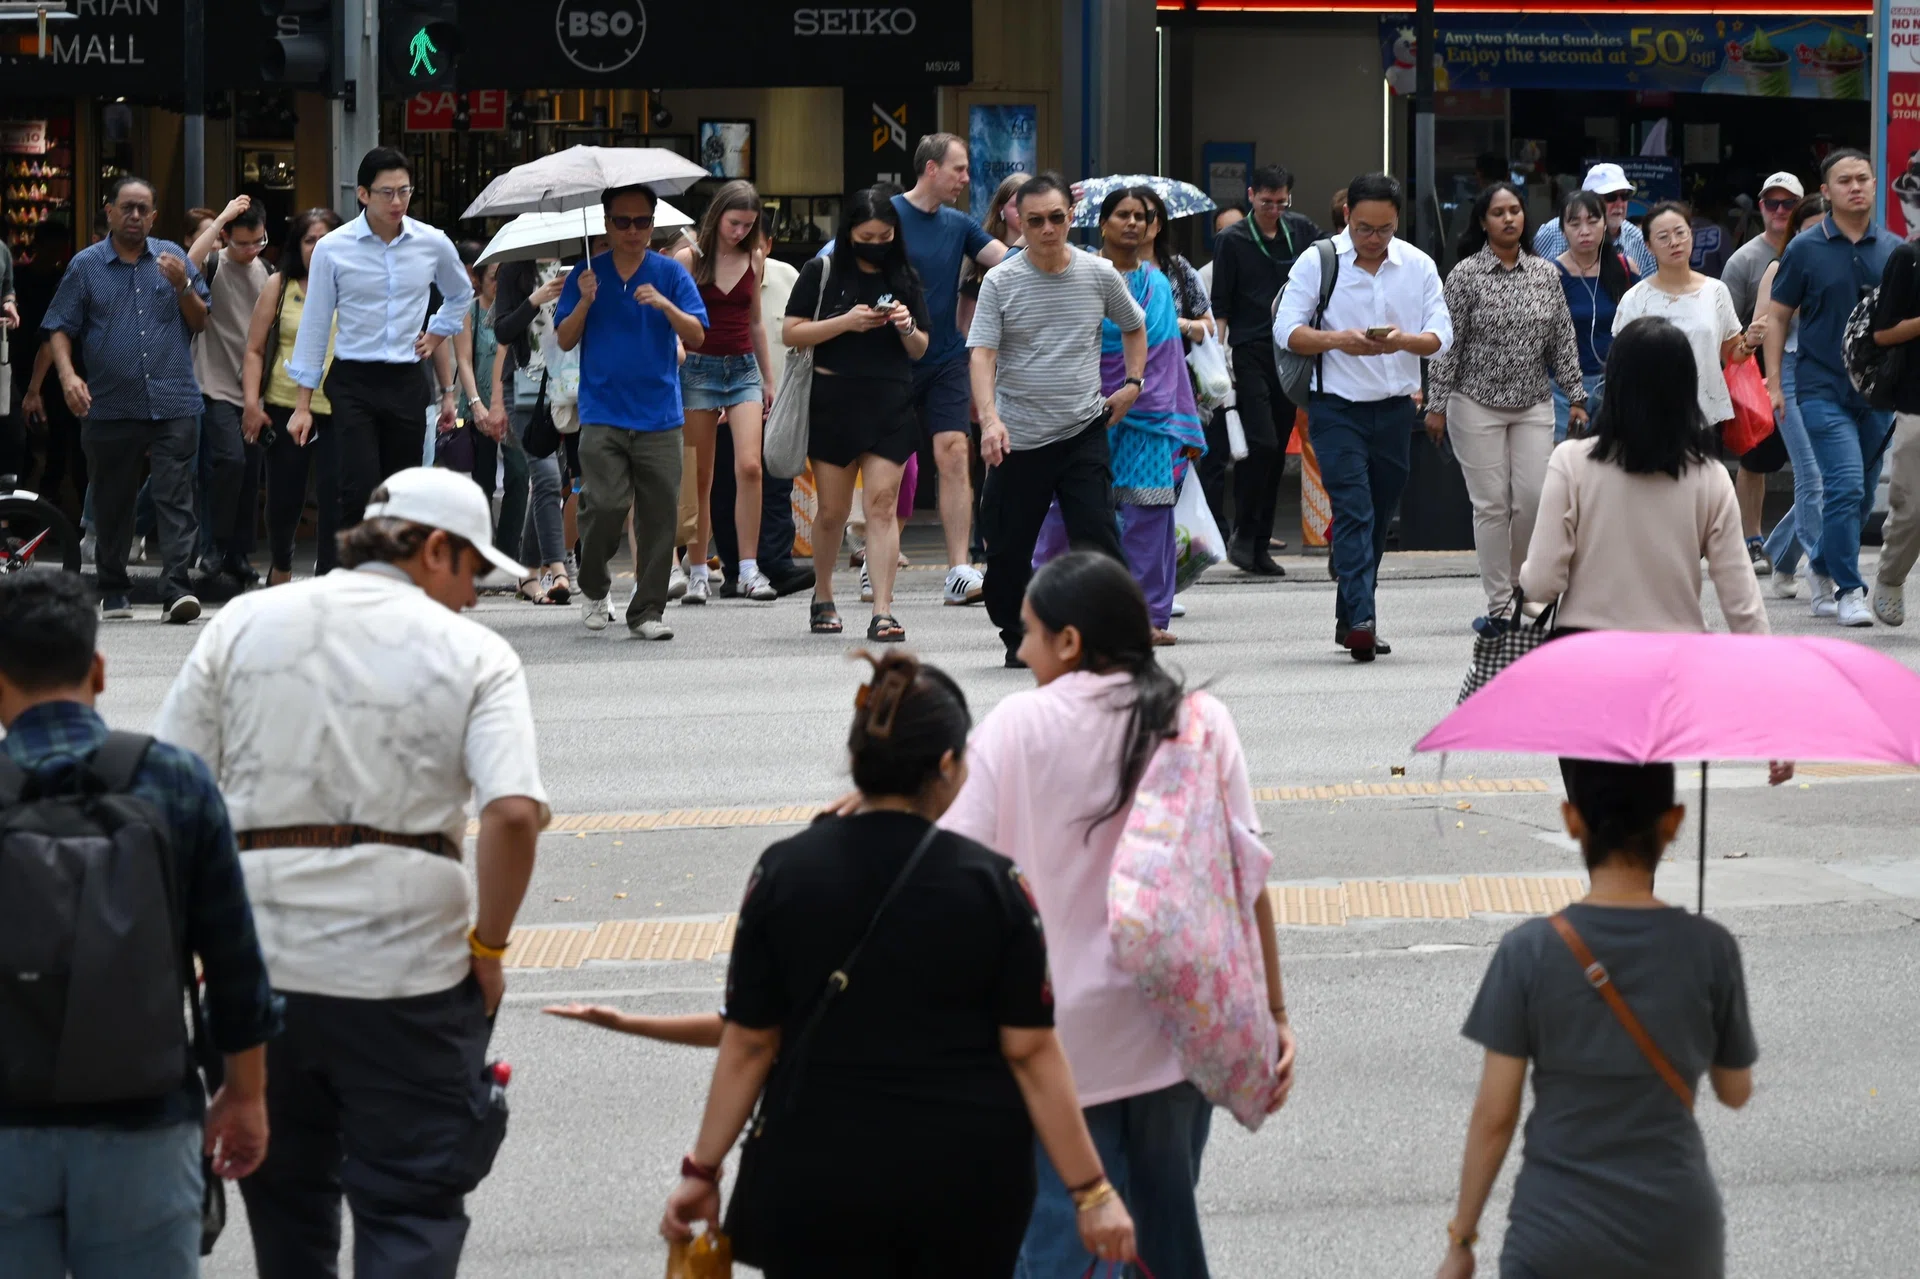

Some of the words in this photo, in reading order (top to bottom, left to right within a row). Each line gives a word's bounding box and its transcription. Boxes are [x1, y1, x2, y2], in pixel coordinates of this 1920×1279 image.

[569, 11, 633, 37] BSO
[793, 8, 916, 36] SEIKO
[1892, 18, 1910, 29] NO
[1445, 32, 1472, 47] Any
[1475, 34, 1502, 44] two
[1506, 33, 1559, 45] Matcha
[1562, 34, 1623, 46] Sundaes
[53, 34, 144, 64] MALL
[1447, 46, 1499, 67] Enjoy
[1505, 46, 1535, 63] the
[1539, 48, 1605, 64] second
[1608, 50, 1627, 64] at
[925, 61, 960, 72] MSV28
[982, 161, 1025, 173] SEIKO
